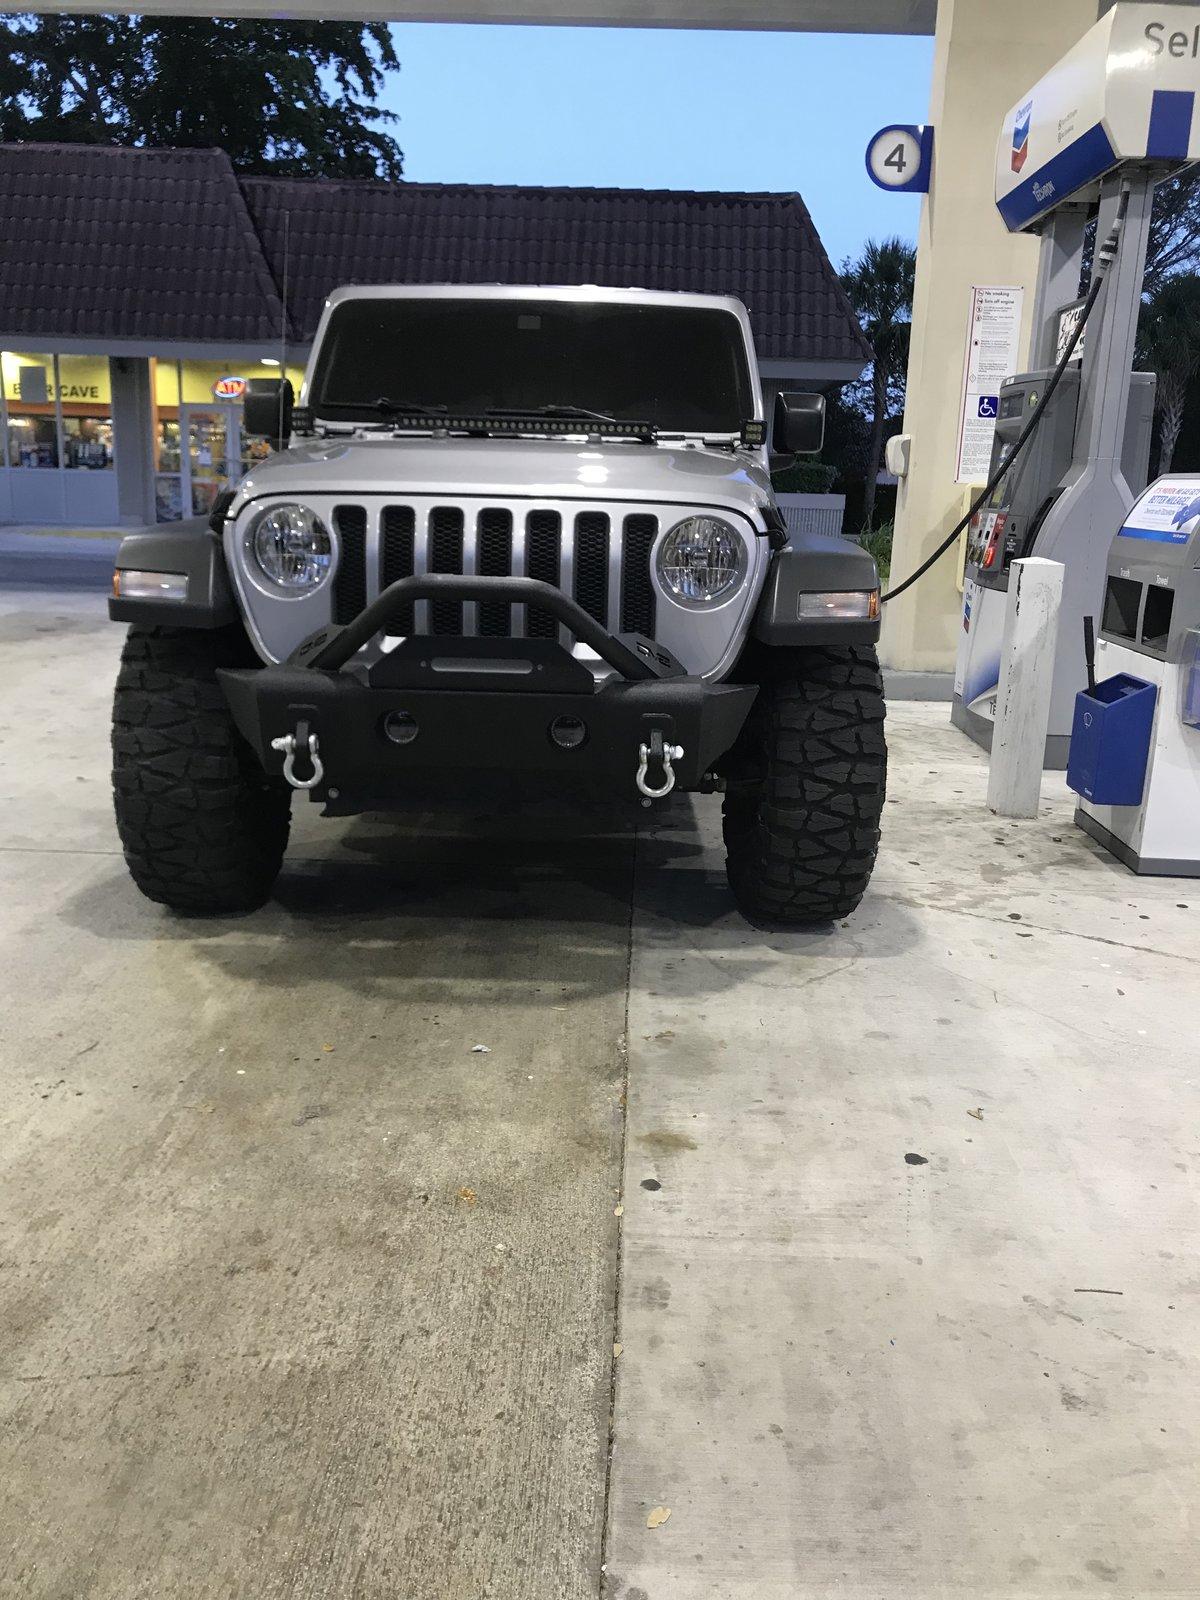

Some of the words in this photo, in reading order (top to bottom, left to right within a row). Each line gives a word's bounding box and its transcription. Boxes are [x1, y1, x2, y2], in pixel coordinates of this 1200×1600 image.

[1144, 22, 1200, 58] Sel
[884, 143, 906, 173] 4
[60, 385, 99, 399] CAVE
